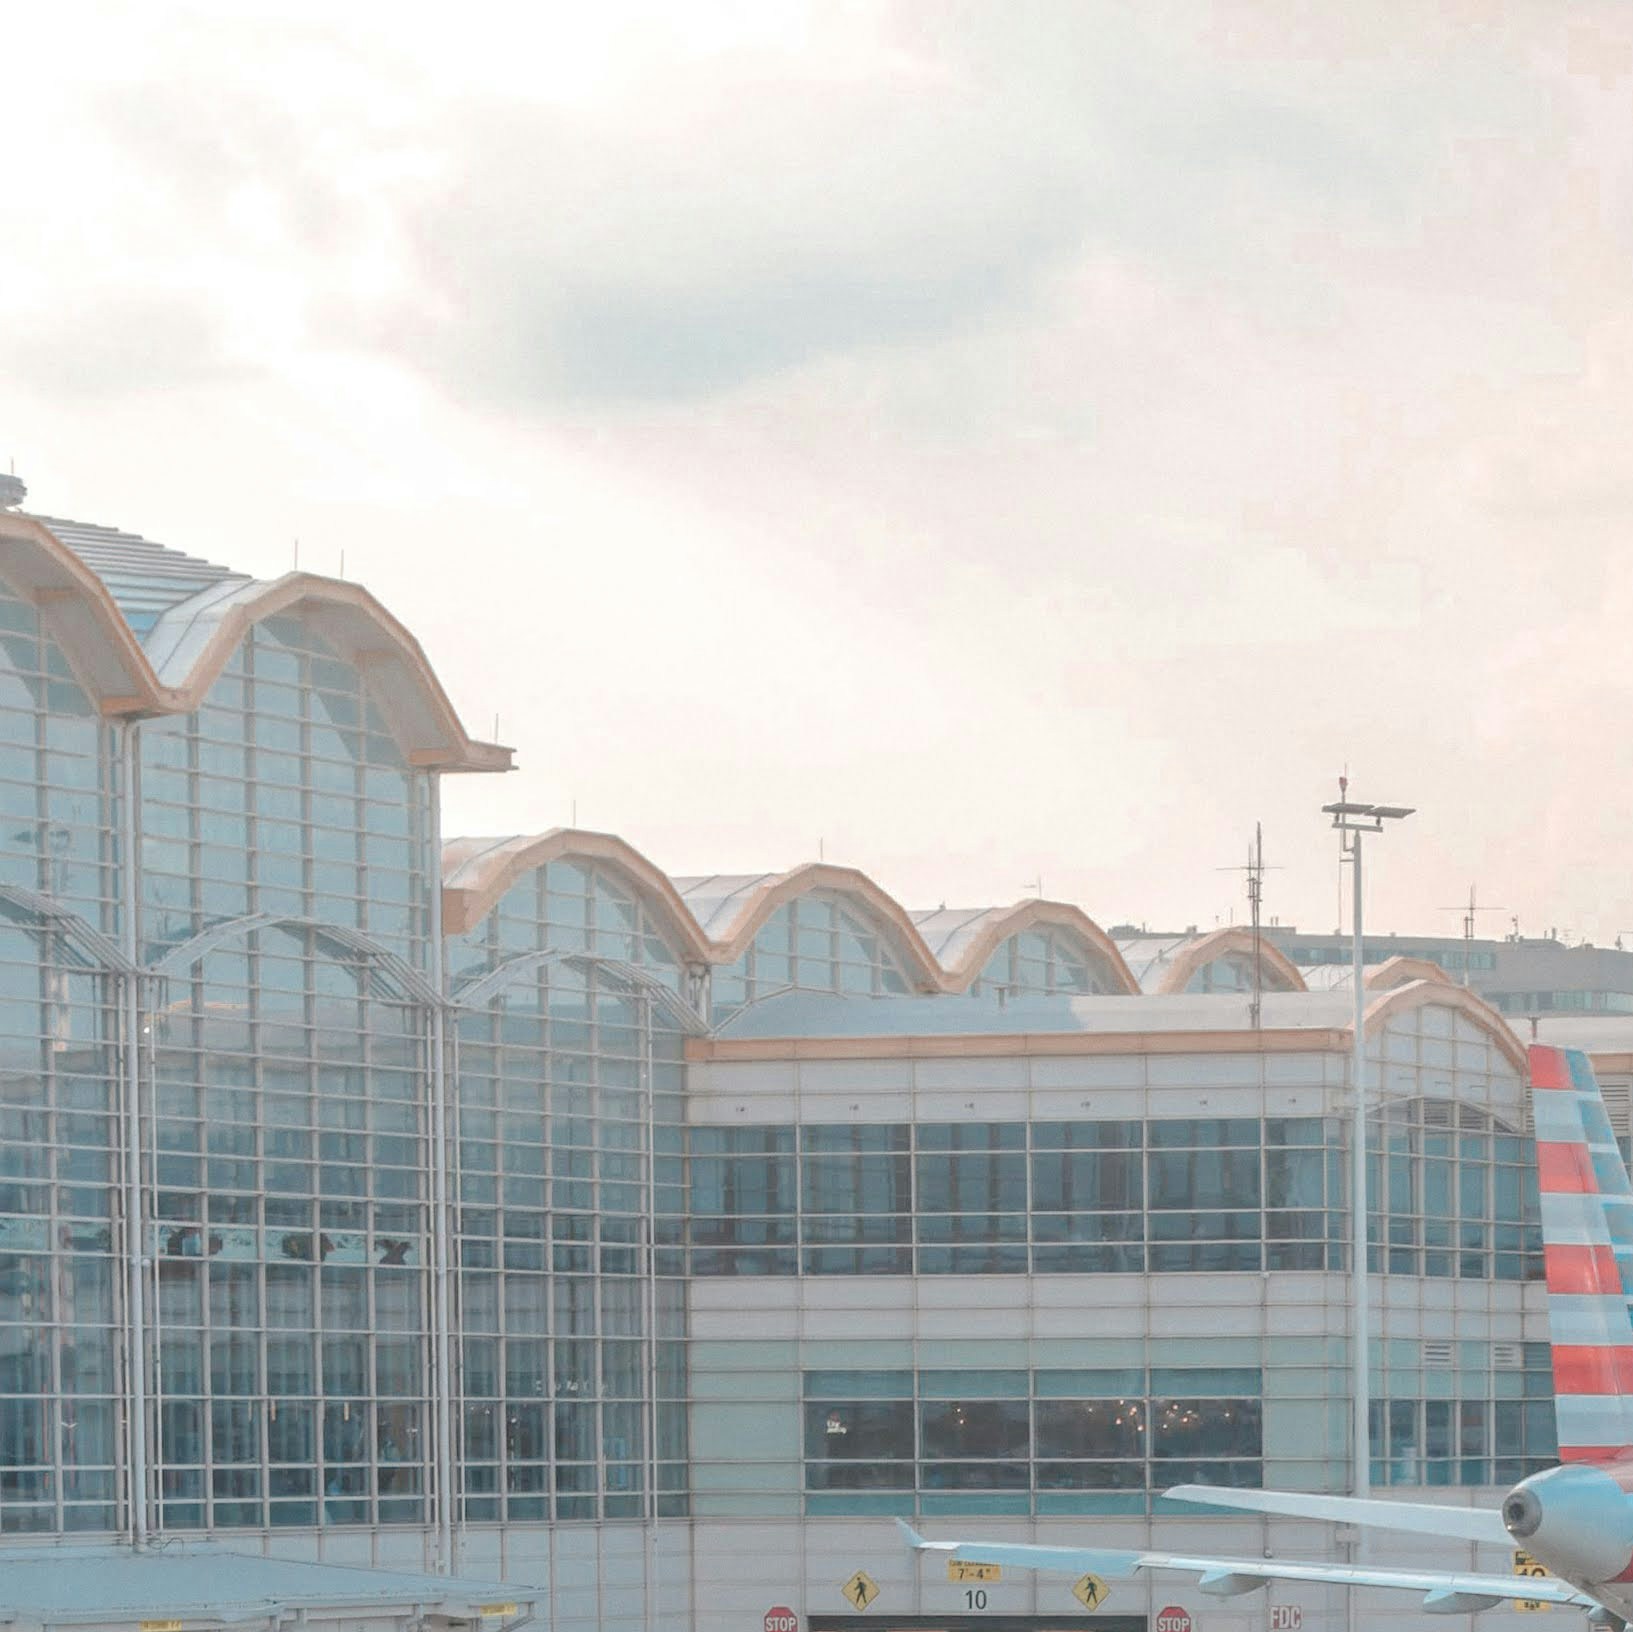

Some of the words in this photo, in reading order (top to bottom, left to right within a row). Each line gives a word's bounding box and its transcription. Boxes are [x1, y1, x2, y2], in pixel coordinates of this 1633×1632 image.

[965, 1590, 987, 1610] 10
[766, 1617, 796, 1632] STOP
[1158, 1617, 1190, 1632] STOP
[1270, 1606, 1301, 1629] FDC
